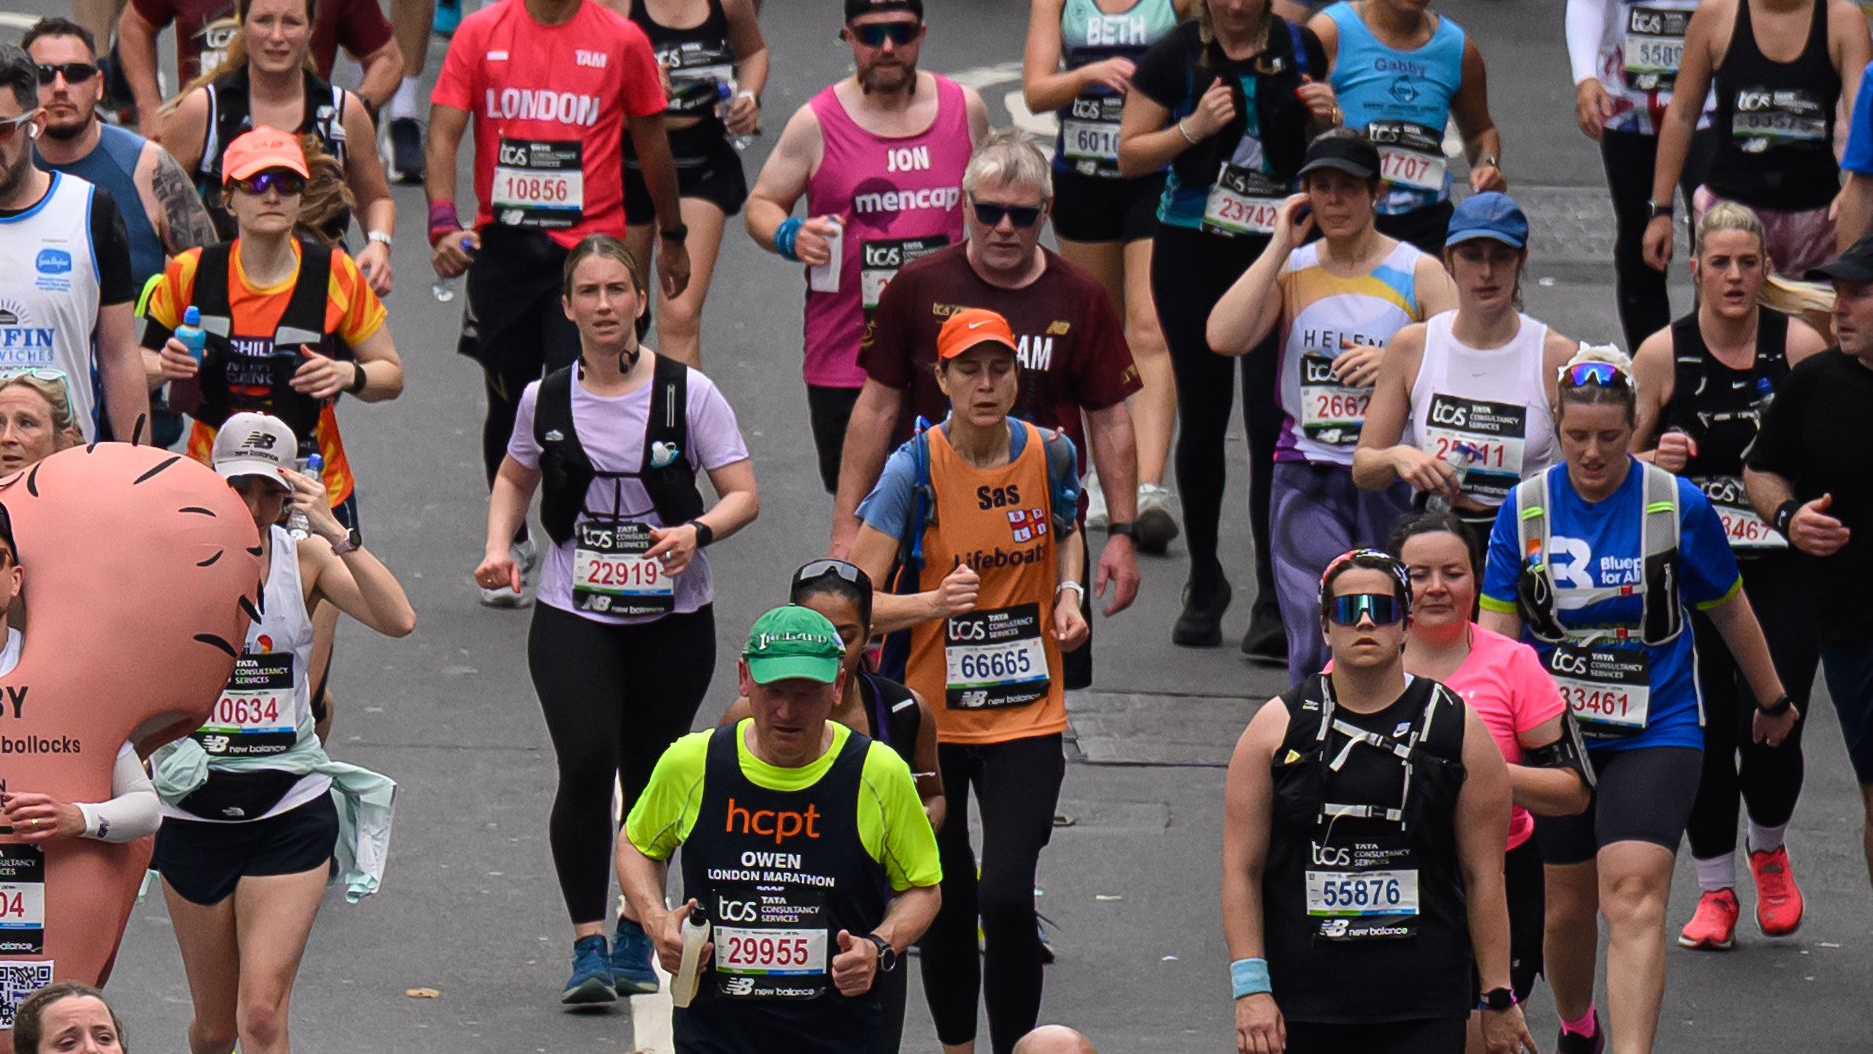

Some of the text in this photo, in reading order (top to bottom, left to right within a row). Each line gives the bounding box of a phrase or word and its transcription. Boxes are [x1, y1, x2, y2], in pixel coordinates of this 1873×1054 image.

[1087, 15, 1146, 46] BETH
[1631, 10, 1661, 34] tcs
[575, 49, 607, 69] TAM
[1374, 58, 1426, 79] Gabby
[486, 89, 600, 127] LONDON
[1072, 98, 1100, 121] tcs
[1737, 91, 1770, 112] tcs
[500, 141, 528, 167] tcs
[887, 147, 929, 172] JON
[506, 177, 568, 201] 10856
[855, 186, 960, 217] mencap
[1219, 198, 1277, 228] 23742
[866, 246, 900, 267] tcs
[1016, 335, 1053, 371] AM
[1432, 397, 1467, 427] tcs
[976, 484, 1021, 511] Sas
[582, 523, 613, 549] tcs
[588, 559, 659, 587] 22919
[1600, 557, 1642, 575] Bluep
[1601, 571, 1620, 584] for
[948, 613, 1009, 642] tcs TATA
[758, 631, 828, 651] IRELAND
[236, 659, 258, 667] TATA
[961, 647, 1031, 680] 66665
[1551, 645, 1587, 674] tcs
[235, 667, 288, 677] CONSULTANCY
[235, 676, 269, 685] SERVICES
[229, 743, 287, 755] new balance
[725, 797, 822, 845] hcpt
[740, 850, 802, 870] OWEN
[1311, 839, 1379, 867] tcs TATA
[1353, 849, 1411, 860] CONSULTANCY
[707, 867, 835, 888] LONDON MARATHON
[1322, 877, 1401, 907] 55876
[718, 895, 787, 922] tcs TATA
[760, 904, 820, 916] CONSULTANCY
[760, 913, 800, 923] SERVICES
[1348, 926, 1408, 937] new balance
[728, 936, 809, 966] 29955
[754, 985, 815, 997] new balance
